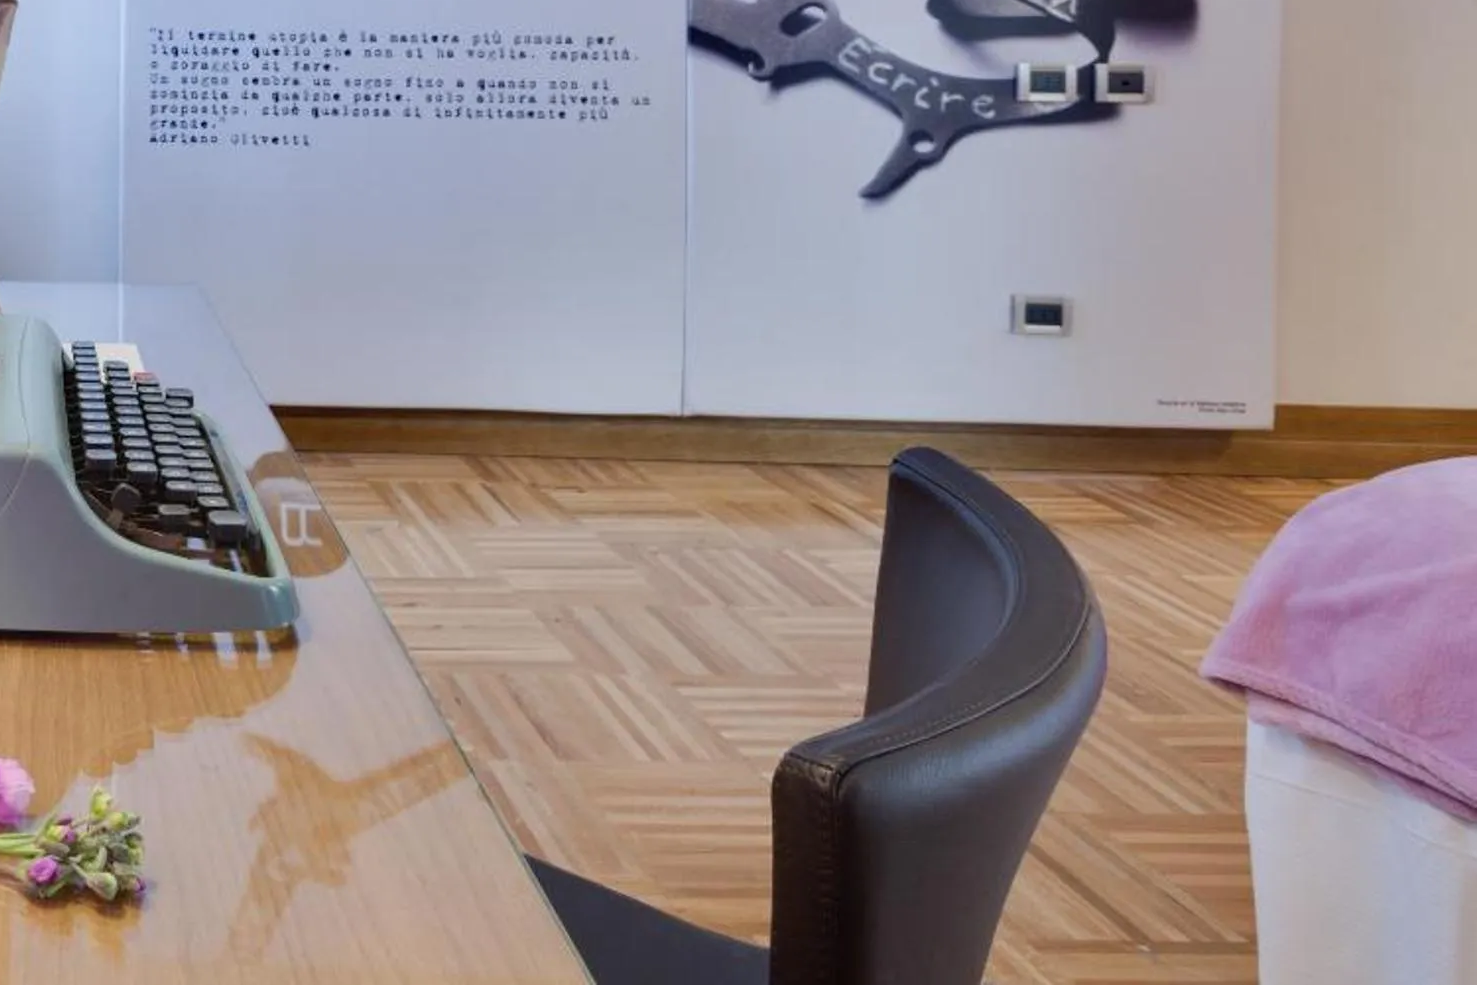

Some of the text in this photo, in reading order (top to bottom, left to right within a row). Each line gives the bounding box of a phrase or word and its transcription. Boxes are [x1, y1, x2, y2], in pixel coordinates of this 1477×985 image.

[188, 29, 256, 42] termine
[360, 30, 378, 43] la
[389, 31, 460, 45] maniera
[586, 35, 616, 48] per
[150, 43, 240, 58] liquidare
[251, 45, 311, 59] quello
[323, 45, 352, 58] che
[364, 47, 394, 59] non
[405, 47, 423, 60] si
[437, 47, 455, 60] ha
[181, 75, 229, 88] sogno
[242, 75, 300, 87] sembra
[313, 77, 332, 87] un
[344, 77, 393, 89] sogno
[405, 77, 444, 89] fino
[456, 78, 465, 89] a
[477, 78, 538, 91] quando
[548, 79, 579, 91] non
[591, 79, 609, 91] si
[150, 89, 229, 101] comincia
[241, 90, 260, 101] da
[271, 90, 341, 104] qualche
[425, 92, 464, 104] solo
[476, 92, 537, 105] allora
[548, 93, 620, 107] diventa
[631, 96, 651, 106] un
[311, 104, 391, 119] qualcosa
[435, 106, 567, 120] infinitamente
